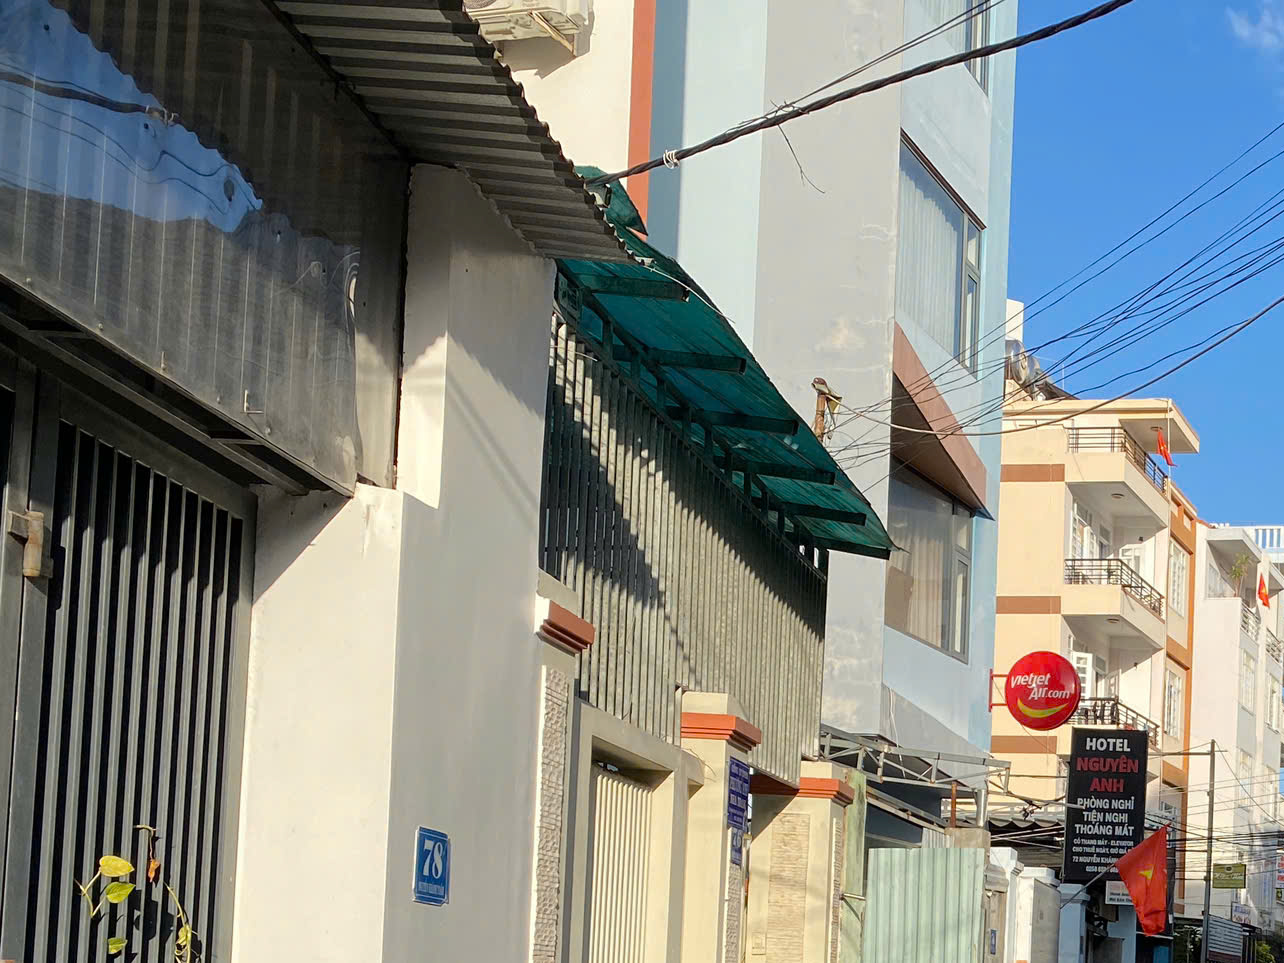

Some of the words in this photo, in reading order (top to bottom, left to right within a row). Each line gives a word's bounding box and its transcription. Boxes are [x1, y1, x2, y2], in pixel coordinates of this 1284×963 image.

[1085, 737, 1131, 752] HOTEL
[1089, 778, 1125, 792] ANH
[1077, 795, 1110, 809] PHÒNG
[1111, 796, 1135, 810] NGHỈ
[1083, 810, 1104, 825] TIỆN
[1105, 812, 1129, 823] NGHI
[1075, 823, 1112, 836] THOÁNG
[1114, 823, 1135, 836] MÁT
[423, 838, 443, 879] 78
